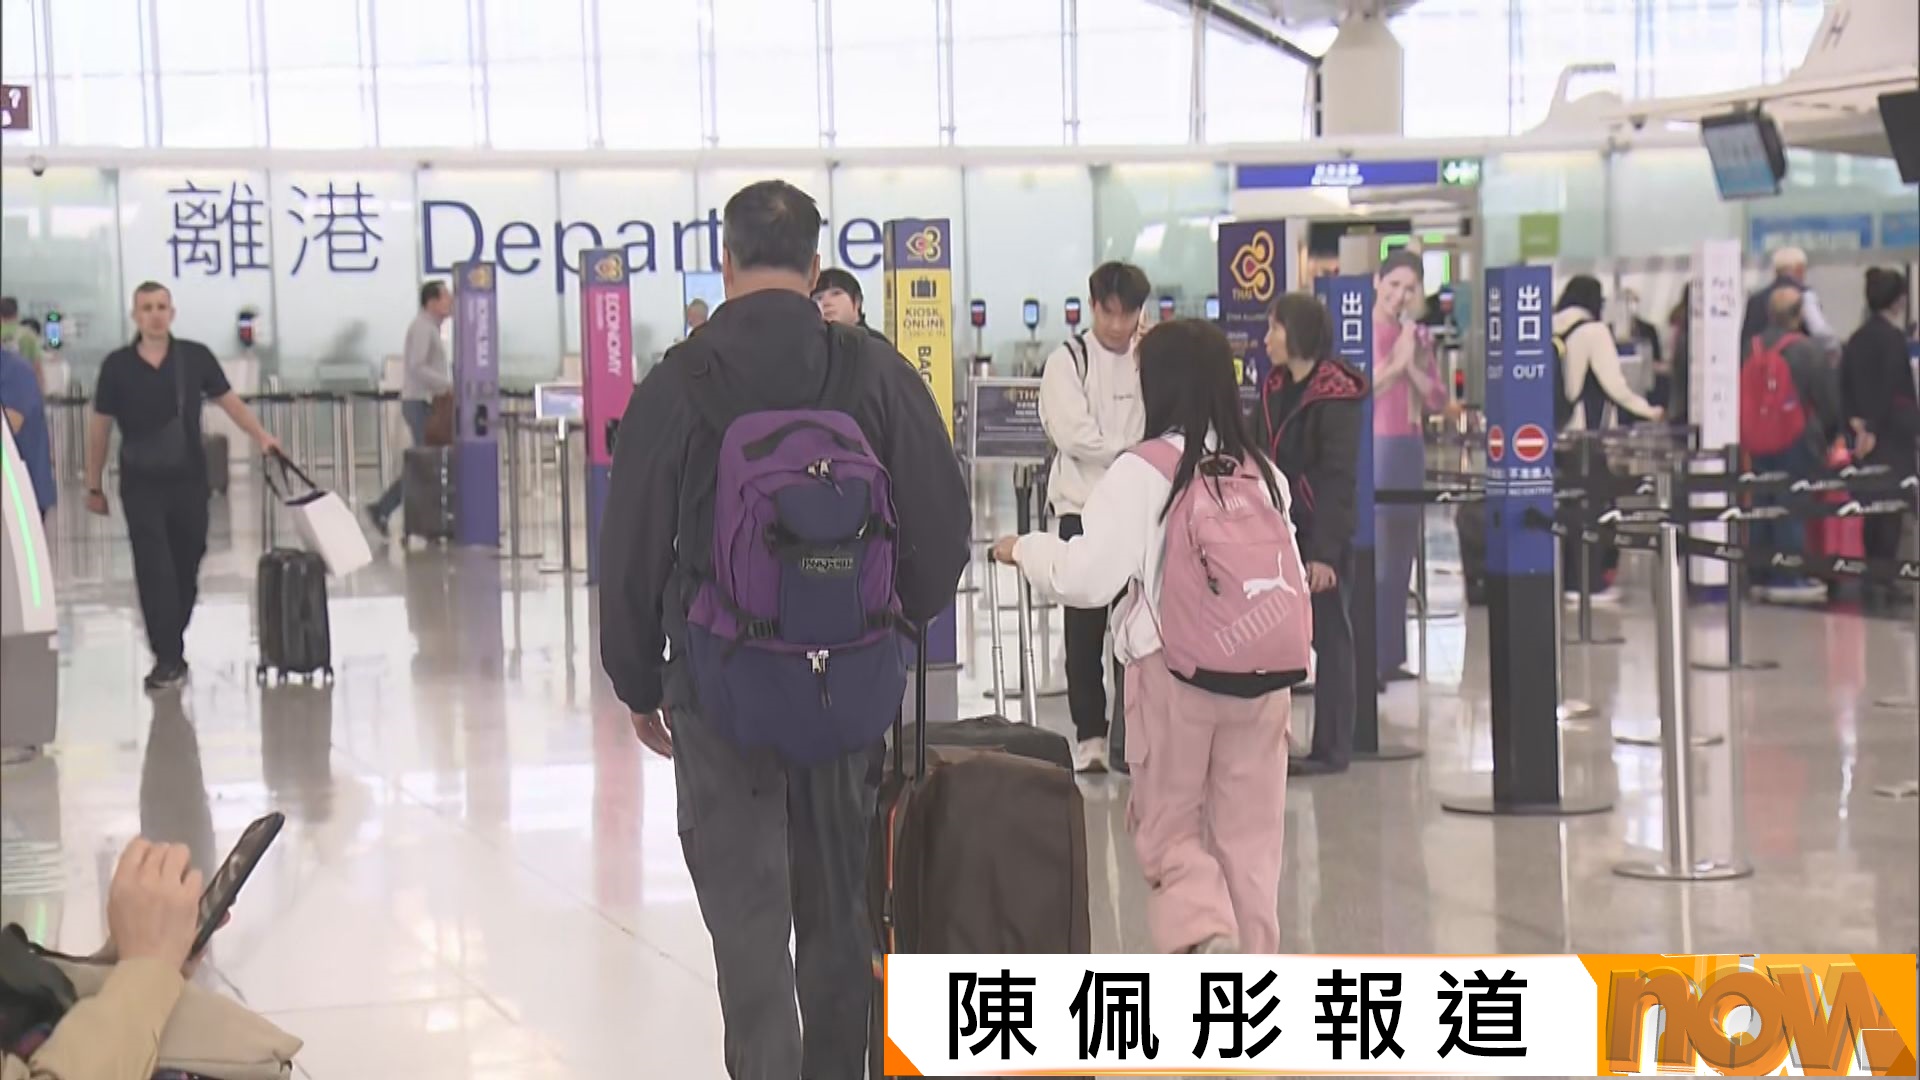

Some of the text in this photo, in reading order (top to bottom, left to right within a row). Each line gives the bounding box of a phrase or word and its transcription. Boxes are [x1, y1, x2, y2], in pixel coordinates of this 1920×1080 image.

[167, 180, 883, 293] 離港 Departe
[605, 292, 622, 376] ECONOMY
[903, 319, 945, 330] ONLINE
[1342, 291, 1363, 343] 出口
[1517, 284, 1542, 342] 出口
[1512, 364, 1546, 380] OUT
